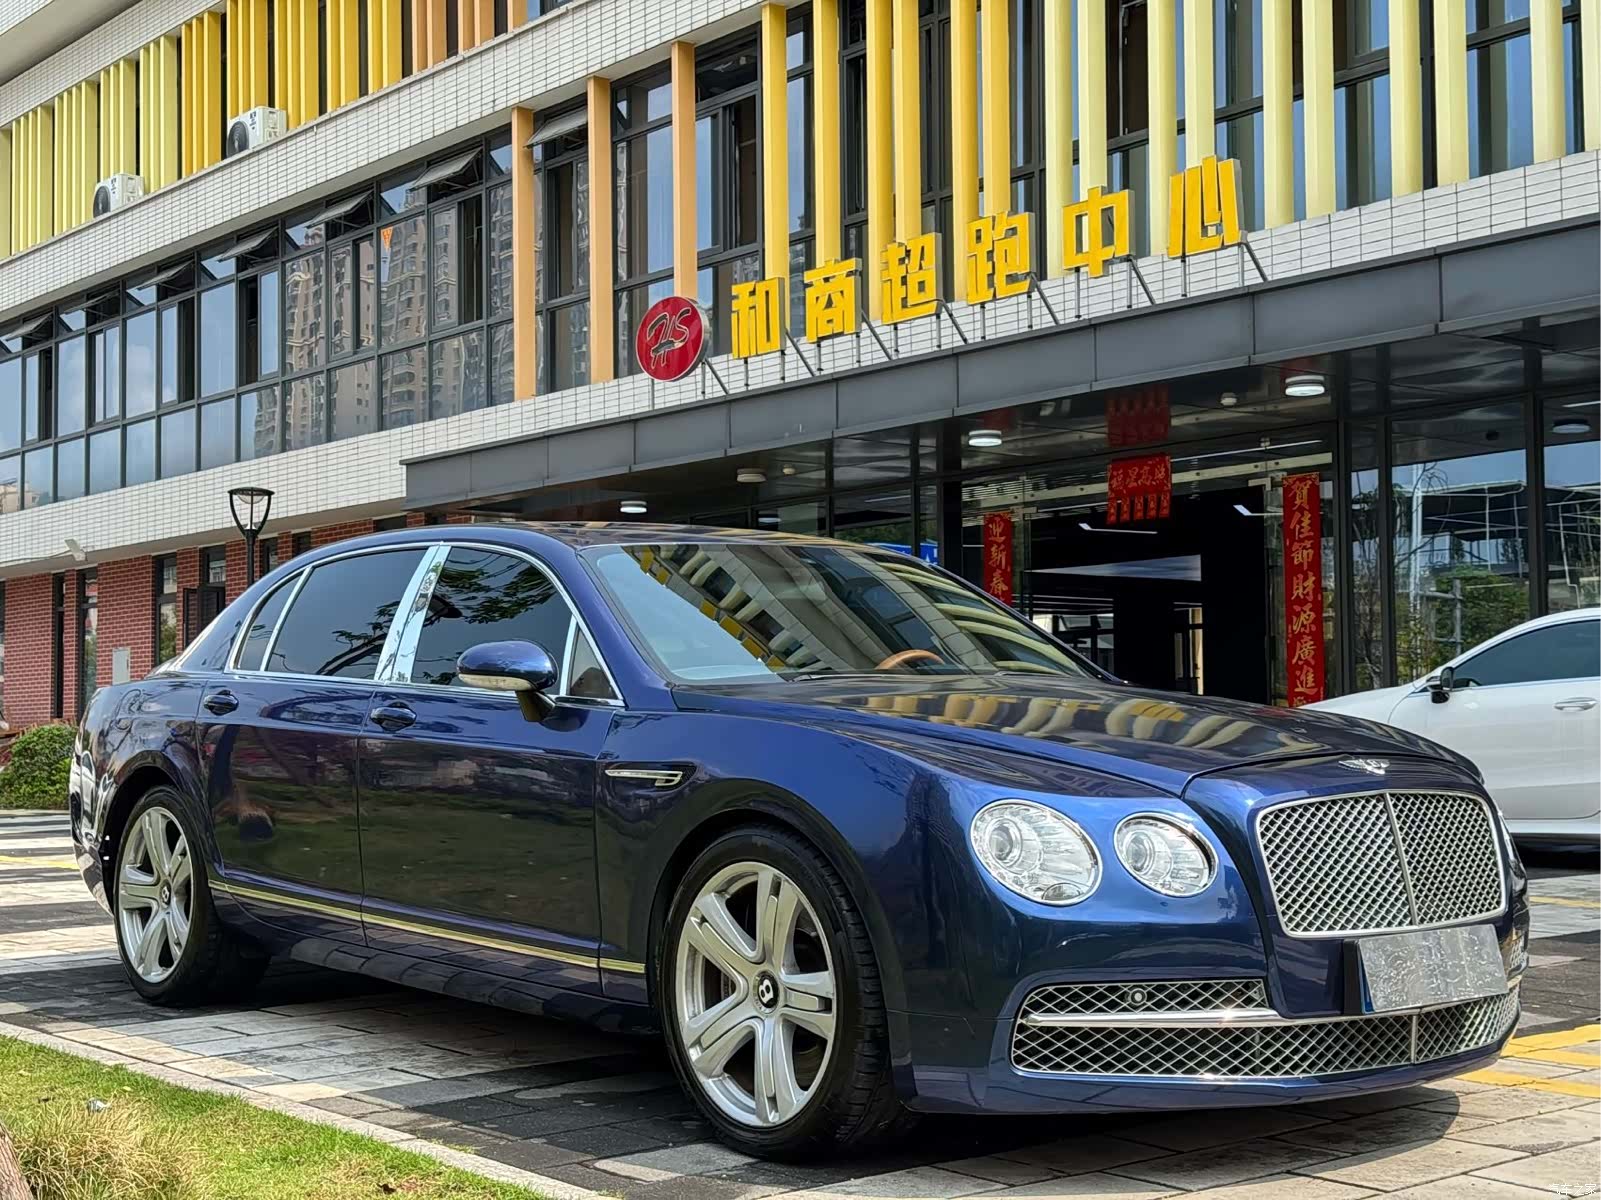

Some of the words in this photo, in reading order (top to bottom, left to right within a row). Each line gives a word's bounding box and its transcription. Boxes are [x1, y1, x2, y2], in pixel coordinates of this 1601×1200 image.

[731, 155, 1242, 358] 和商超跑中心
[987, 517, 1009, 601] 迎新春
[1288, 479, 1318, 695] 賀佳節財源廣進
